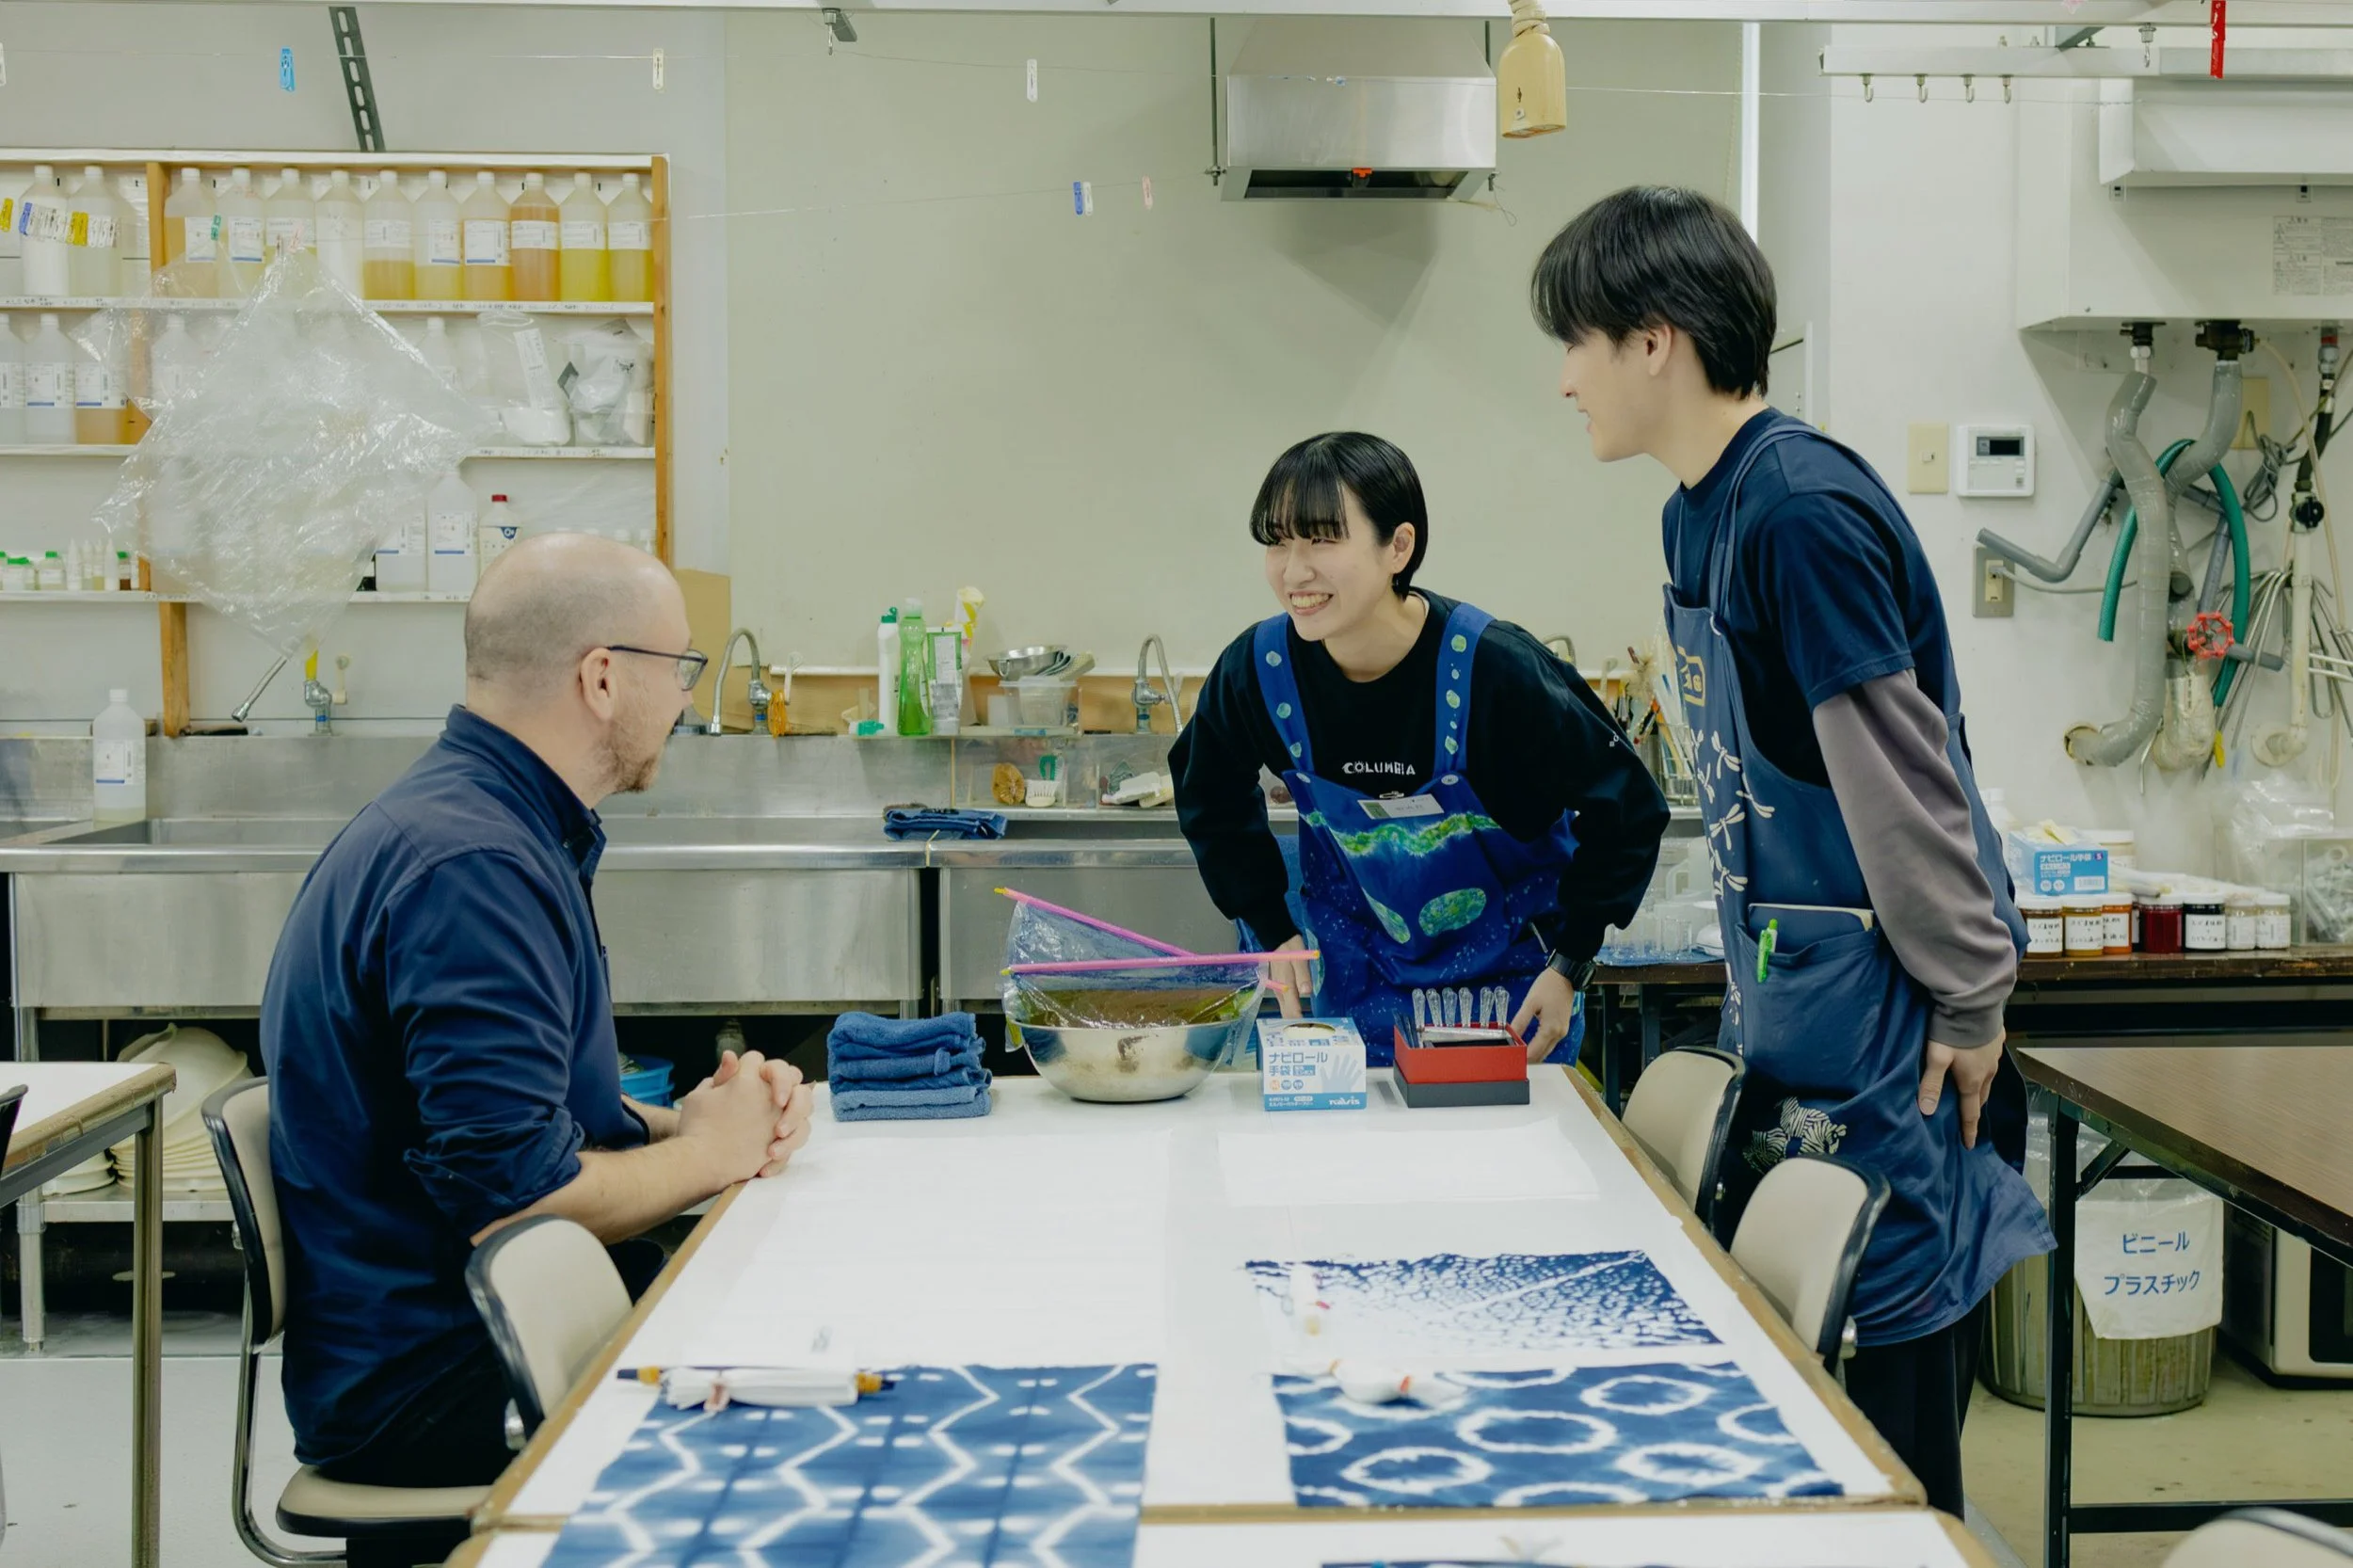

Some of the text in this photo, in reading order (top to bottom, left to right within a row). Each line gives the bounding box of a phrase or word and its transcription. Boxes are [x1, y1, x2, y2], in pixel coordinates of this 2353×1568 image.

[1342, 760, 1416, 776] COLUMBIA
[1269, 1052, 1328, 1064] ナビロール
[2122, 1231, 2189, 1254] ビニール
[2104, 1270, 2201, 1295] プラスチック
